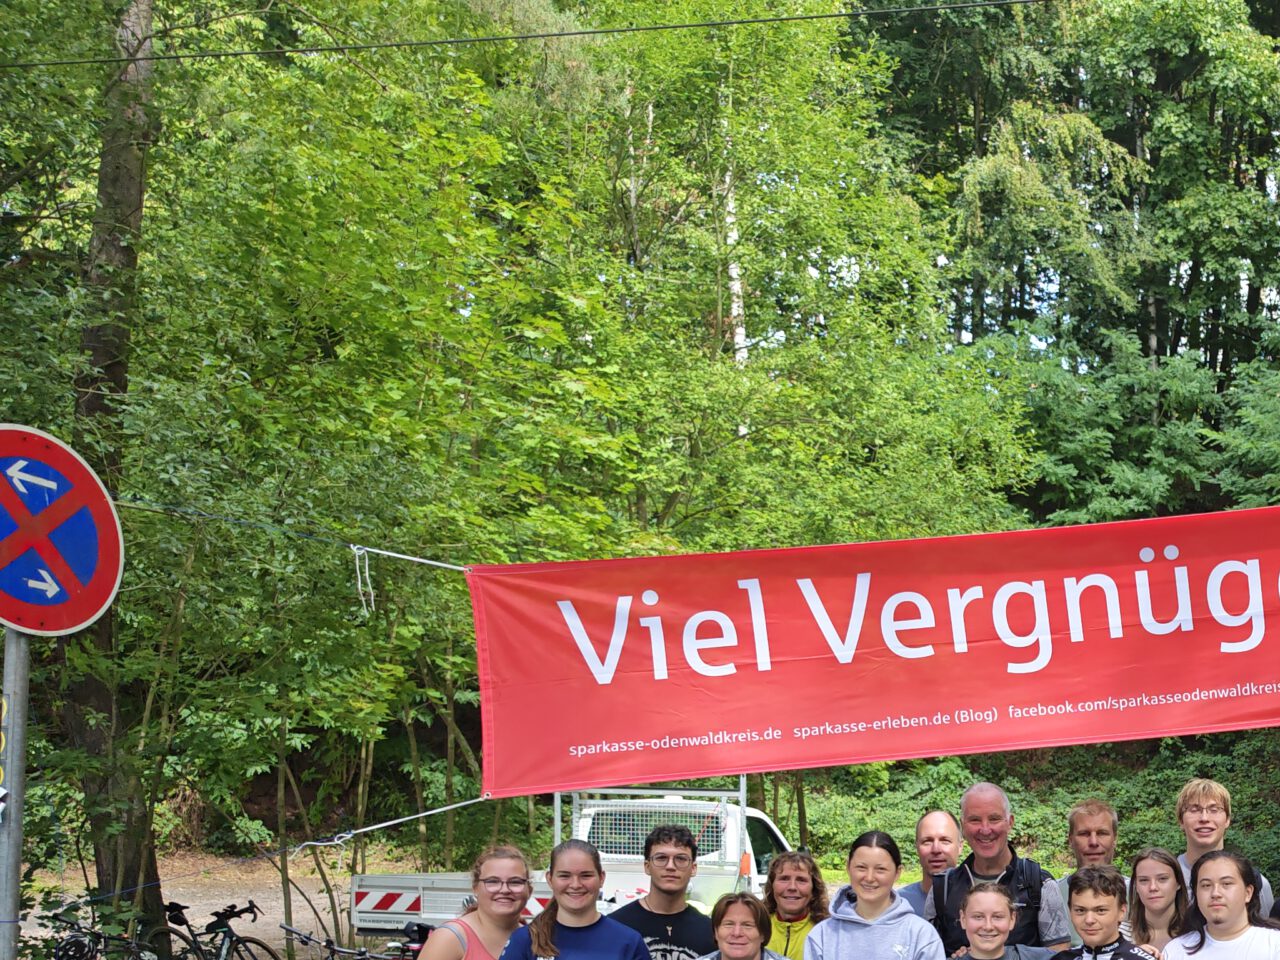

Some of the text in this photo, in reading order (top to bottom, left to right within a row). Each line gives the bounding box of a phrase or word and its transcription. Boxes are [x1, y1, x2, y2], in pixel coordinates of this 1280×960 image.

[557, 578, 772, 686] Viel
[569, 727, 782, 757] sparkasse-odenwaldkreis.de
[793, 711, 951, 739] sparkasse-erleben.de
[954, 706, 999, 726] (Blog)
